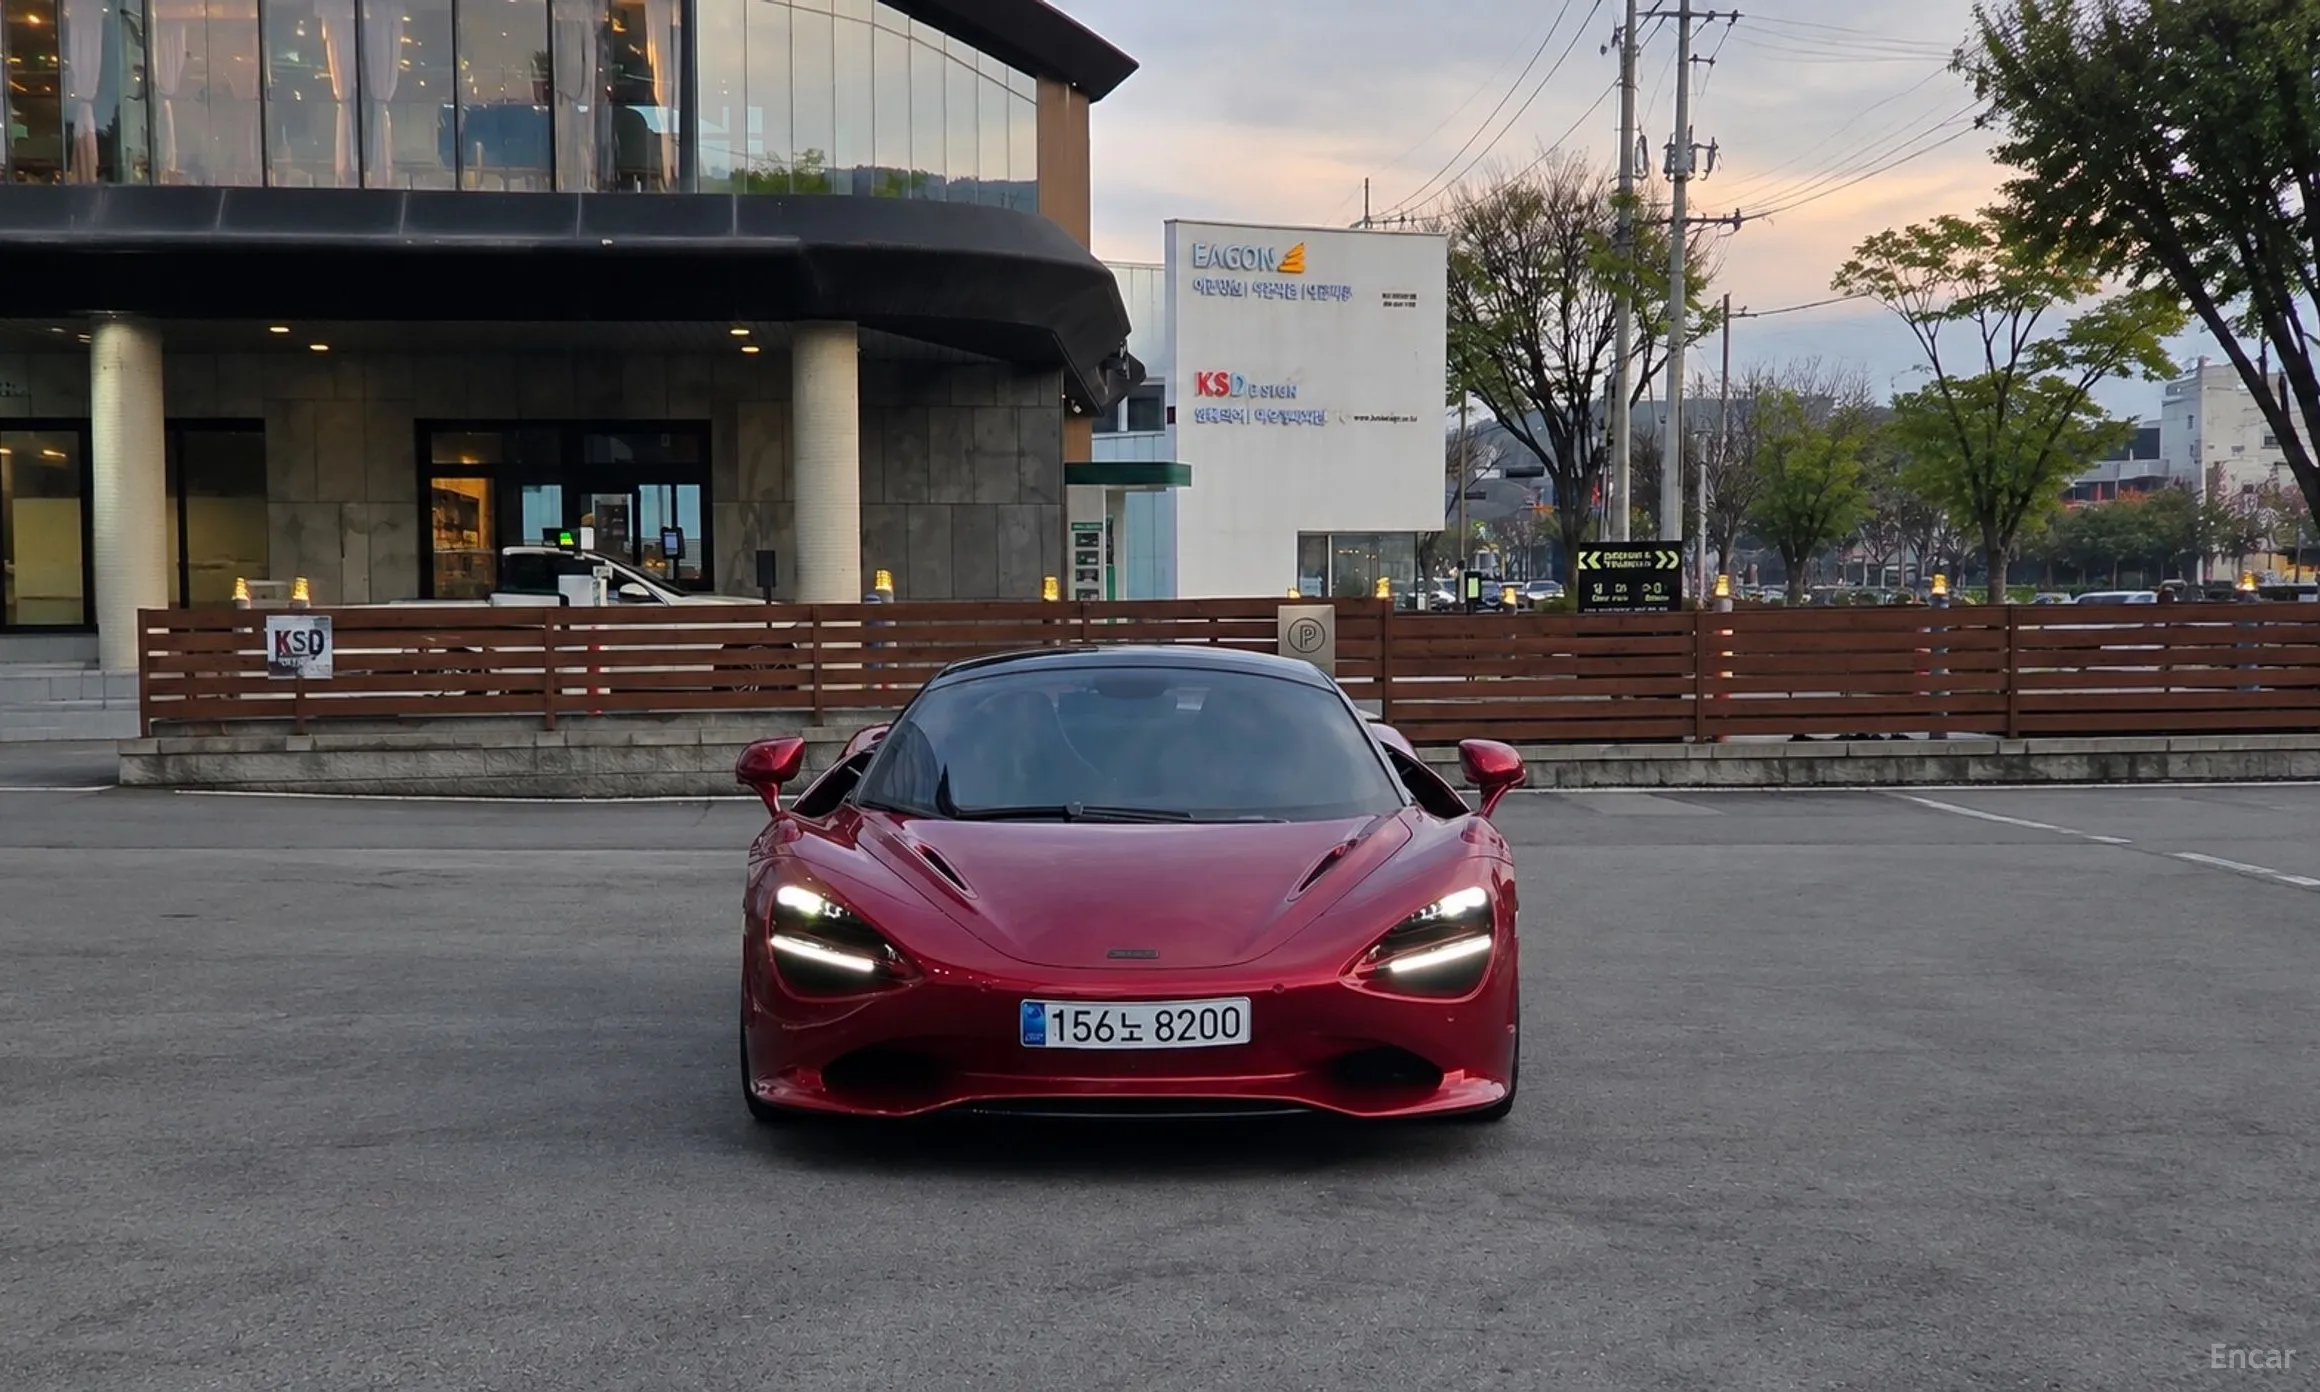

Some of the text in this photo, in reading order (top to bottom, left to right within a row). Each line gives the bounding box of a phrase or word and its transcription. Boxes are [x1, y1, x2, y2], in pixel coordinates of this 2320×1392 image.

[1193, 242, 1275, 272] EAGON
[275, 629, 324, 657] KSD
[1299, 624, 1317, 649] P
[1052, 1006, 1241, 1042] 156노 8200
